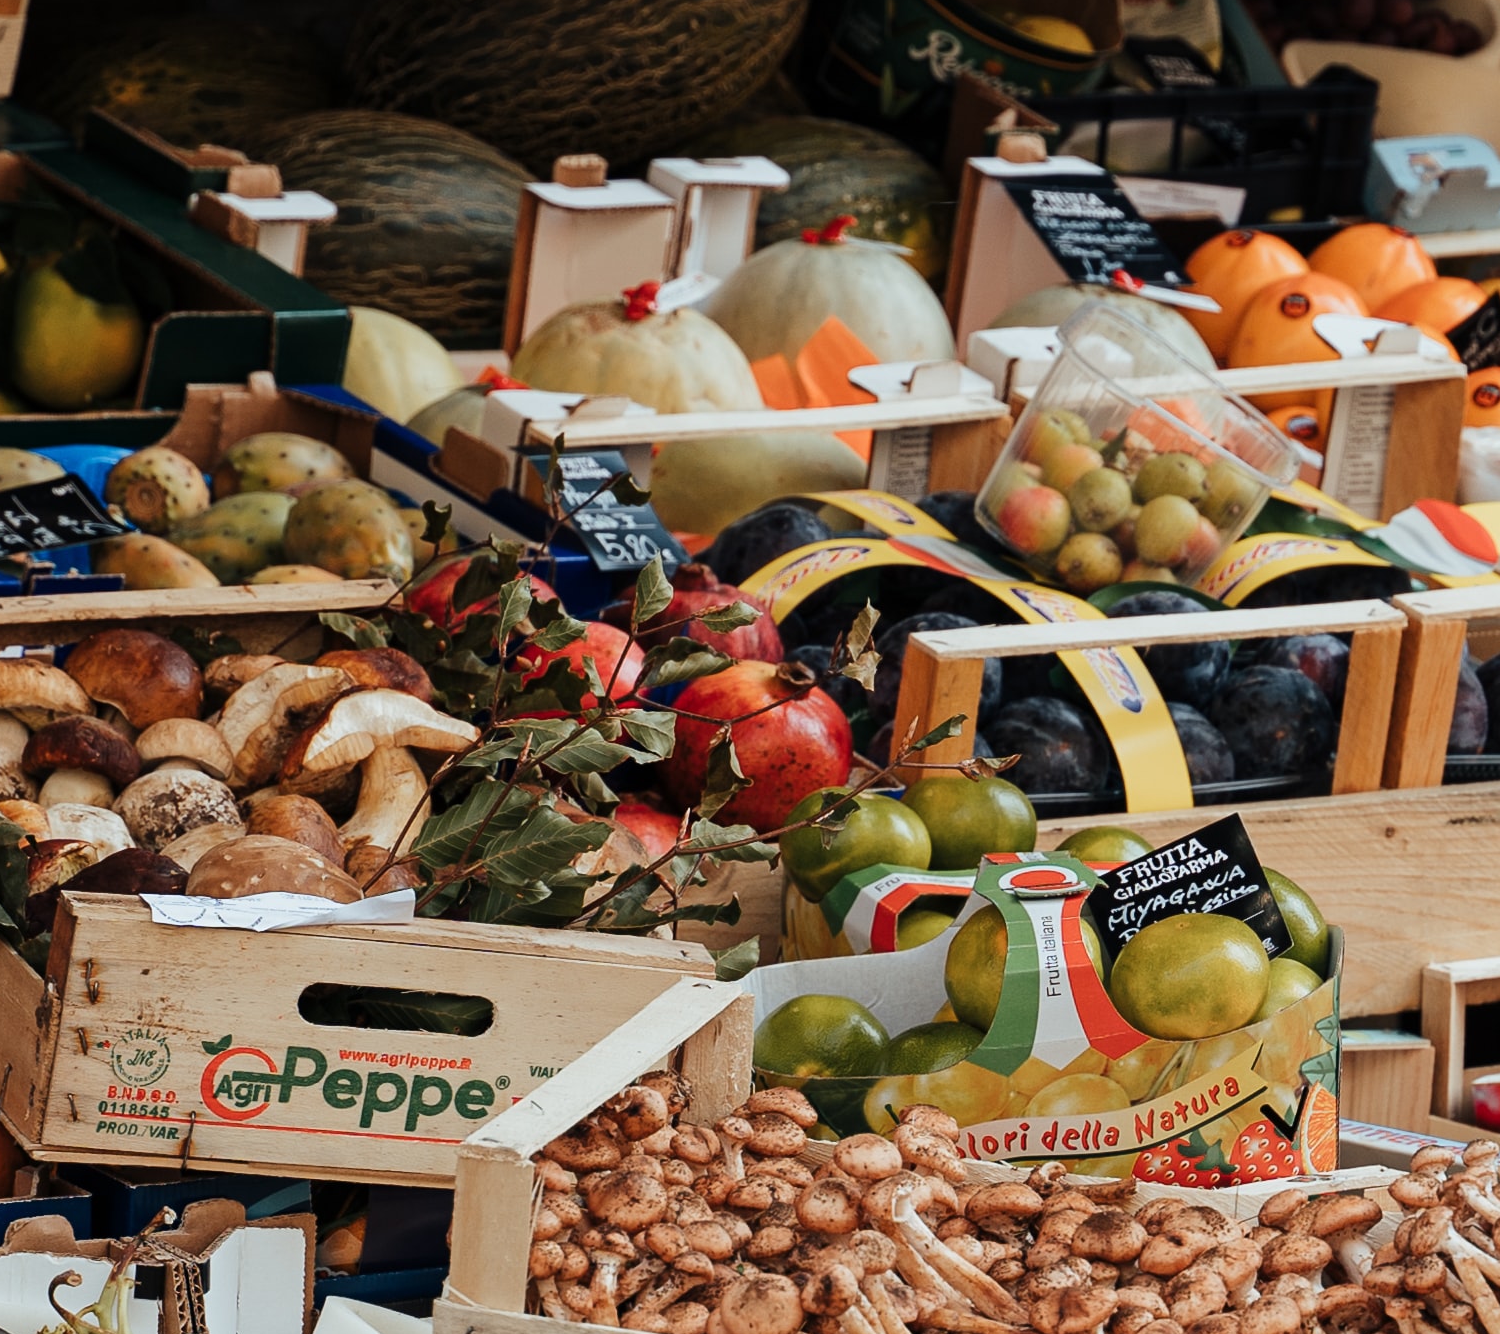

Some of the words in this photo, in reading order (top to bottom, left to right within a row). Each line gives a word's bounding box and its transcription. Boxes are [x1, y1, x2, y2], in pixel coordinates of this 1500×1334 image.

[1115, 836, 1209, 884] FRUTTA
[1042, 914, 1054, 950] italiana
[1045, 951, 1062, 998] Frutta
[121, 1027, 167, 1050] ITALIA
[99, 1100, 171, 1120] 0118545
[213, 1079, 272, 1109] Agri
[957, 1121, 1030, 1162] lori
[1041, 1118, 1120, 1151] della
[1134, 1074, 1241, 1144] Natura
